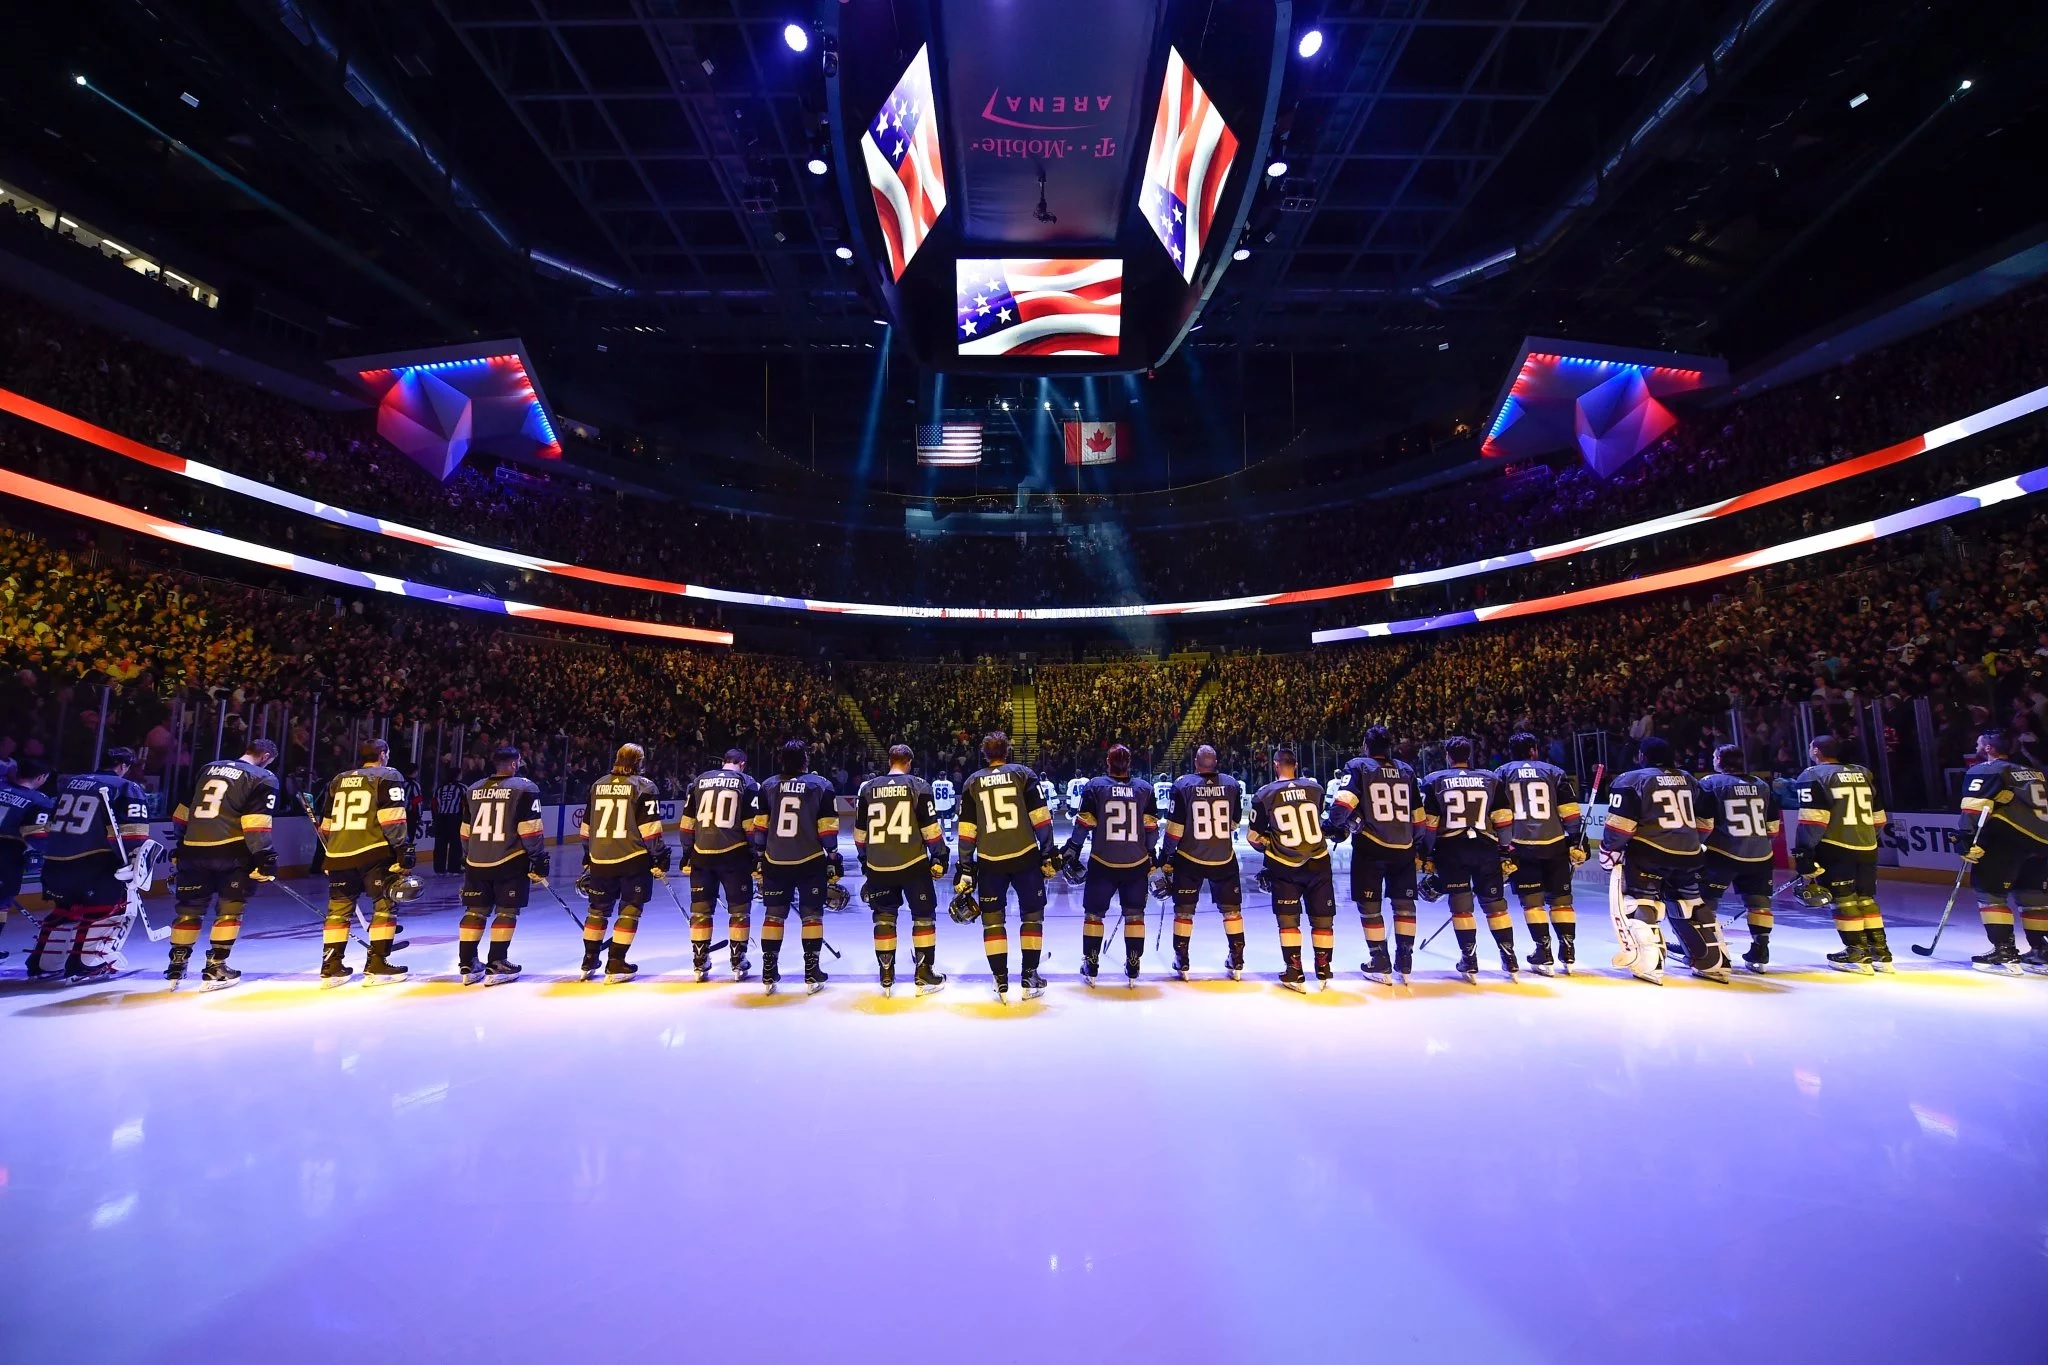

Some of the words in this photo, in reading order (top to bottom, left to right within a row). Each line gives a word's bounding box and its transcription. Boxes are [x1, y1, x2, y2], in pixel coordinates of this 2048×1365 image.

[1005, 95, 1112, 113] ARENA
[207, 766, 243, 780] McNABB
[979, 772, 1013, 787] MERRILL
[1381, 767, 1400, 779] TUCH
[1518, 768, 1539, 779] NEAL
[1656, 775, 1688, 786] SUBBAN
[1837, 772, 1866, 784] REAVES
[67, 779, 97, 791] FLEURY
[340, 777, 364, 788] NOSEK
[595, 784, 632, 796] KARLSSON
[698, 777, 740, 789] CARPENTER
[779, 782, 806, 794] MILLER
[1443, 777, 1485, 789] THEODORE
[1968, 778, 1984, 791] 5
[471, 788, 512, 800] BELLEMARE
[872, 785, 908, 799] LINDBERG
[935, 787, 949, 800] 68
[1112, 786, 1134, 798] EAKIN
[1195, 786, 1226, 797] SCHMIDT
[1280, 788, 1307, 802] TATAR
[1734, 785, 1759, 796] HAULA
[193, 779, 229, 819] 3
[265, 794, 276, 809] 3
[531, 799, 542, 813] 4
[1369, 782, 1411, 822] 89
[1509, 781, 1551, 820] 18
[1830, 786, 1874, 826] 75
[2030, 783, 2048, 822] 5
[50, 793, 100, 835] 29
[127, 803, 148, 819] 29
[329, 790, 372, 832] 92
[644, 800, 660, 815] 71
[697, 789, 739, 829] 40
[978, 786, 1019, 834] 15
[1443, 789, 1488, 830] 27
[1651, 789, 1697, 829] 30
[472, 801, 506, 842] 41
[594, 798, 628, 839] 71
[776, 796, 801, 838] 6
[867, 800, 912, 845] 24
[1105, 800, 1138, 842] 21
[1191, 800, 1230, 840] 88
[1724, 798, 1768, 837] 56
[1273, 802, 1323, 848] 90
[112, 915, 132, 951] CCM
